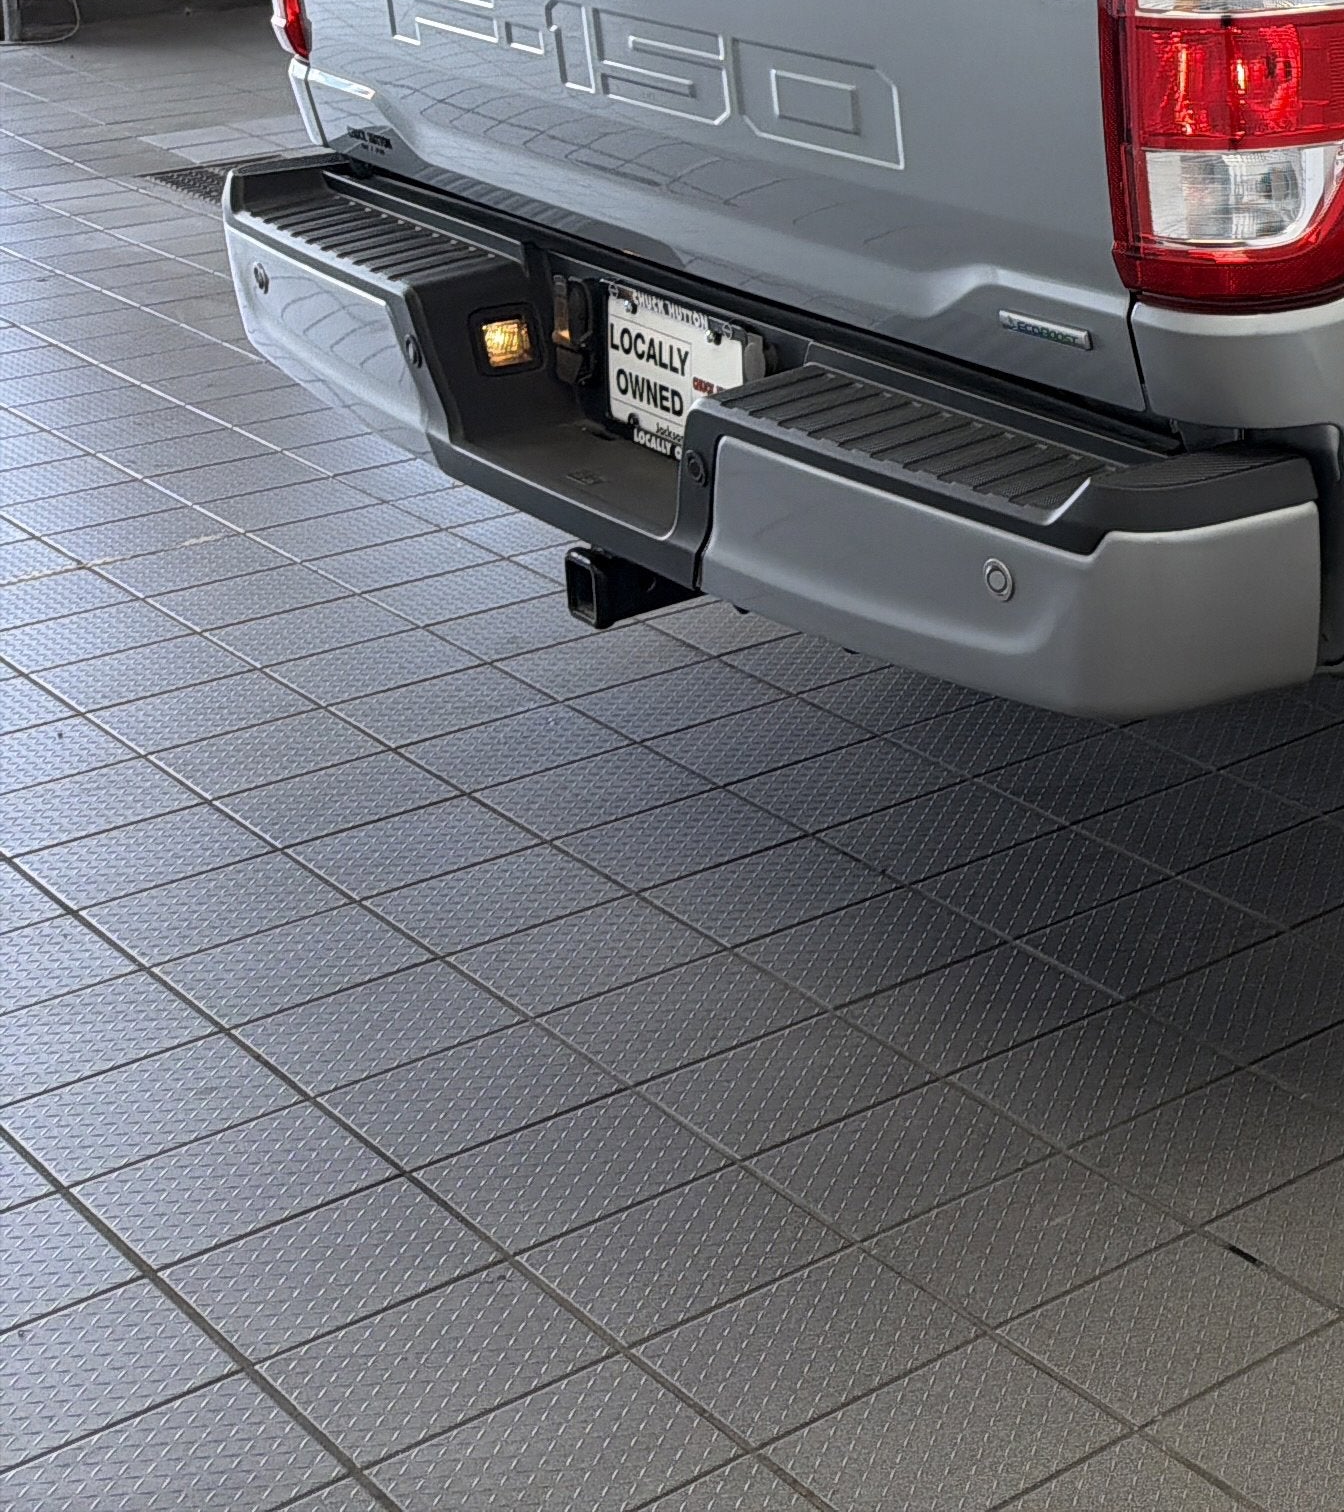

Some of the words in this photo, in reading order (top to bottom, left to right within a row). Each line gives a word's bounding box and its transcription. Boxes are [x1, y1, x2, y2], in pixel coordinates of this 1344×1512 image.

[632, 289, 665, 315] CHUCK
[666, 300, 709, 331] HUTTON
[610, 322, 690, 377] LOCALLY
[616, 368, 684, 417] OWNED
[633, 427, 672, 456] LOCALLY
